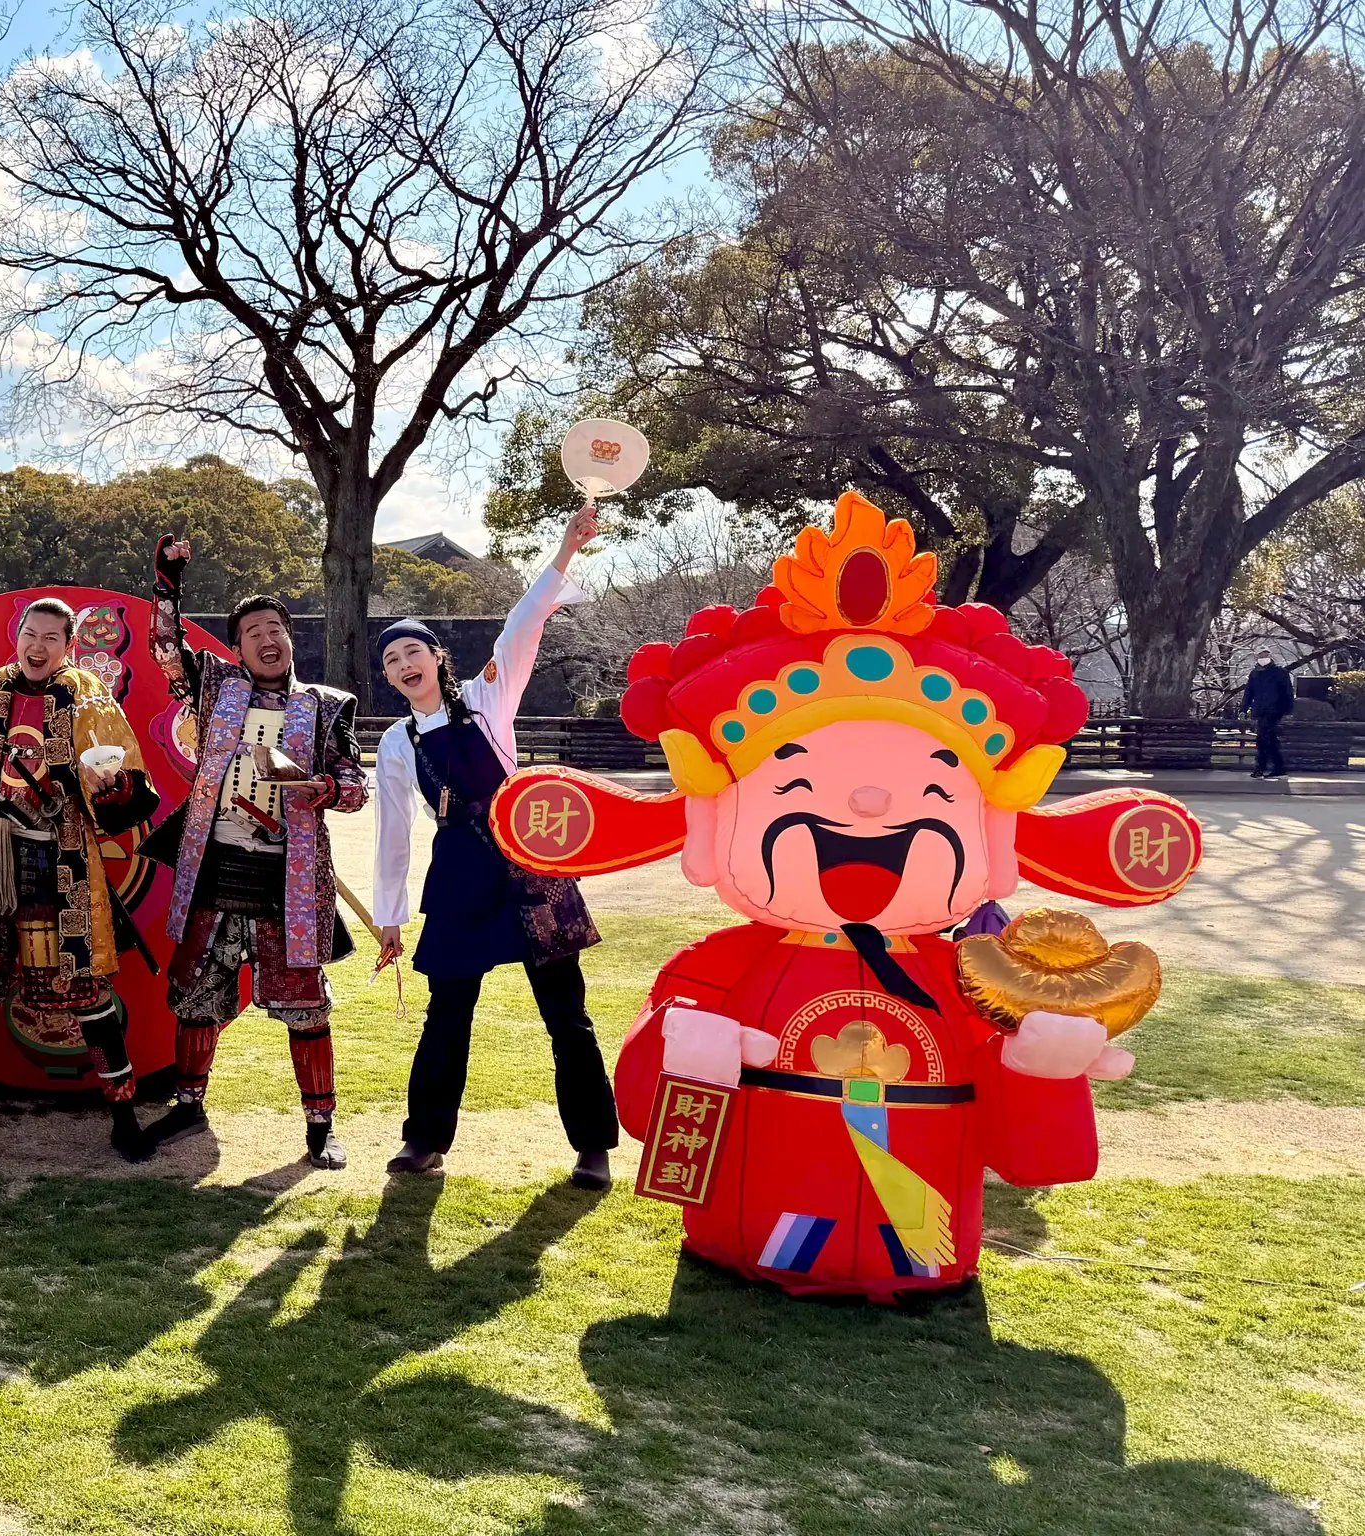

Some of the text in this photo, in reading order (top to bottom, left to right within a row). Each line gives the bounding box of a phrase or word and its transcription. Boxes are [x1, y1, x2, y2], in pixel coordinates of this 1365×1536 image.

[522, 796, 581, 847] 財
[1124, 822, 1181, 876] 財
[656, 1093, 717, 1194] 財神到
